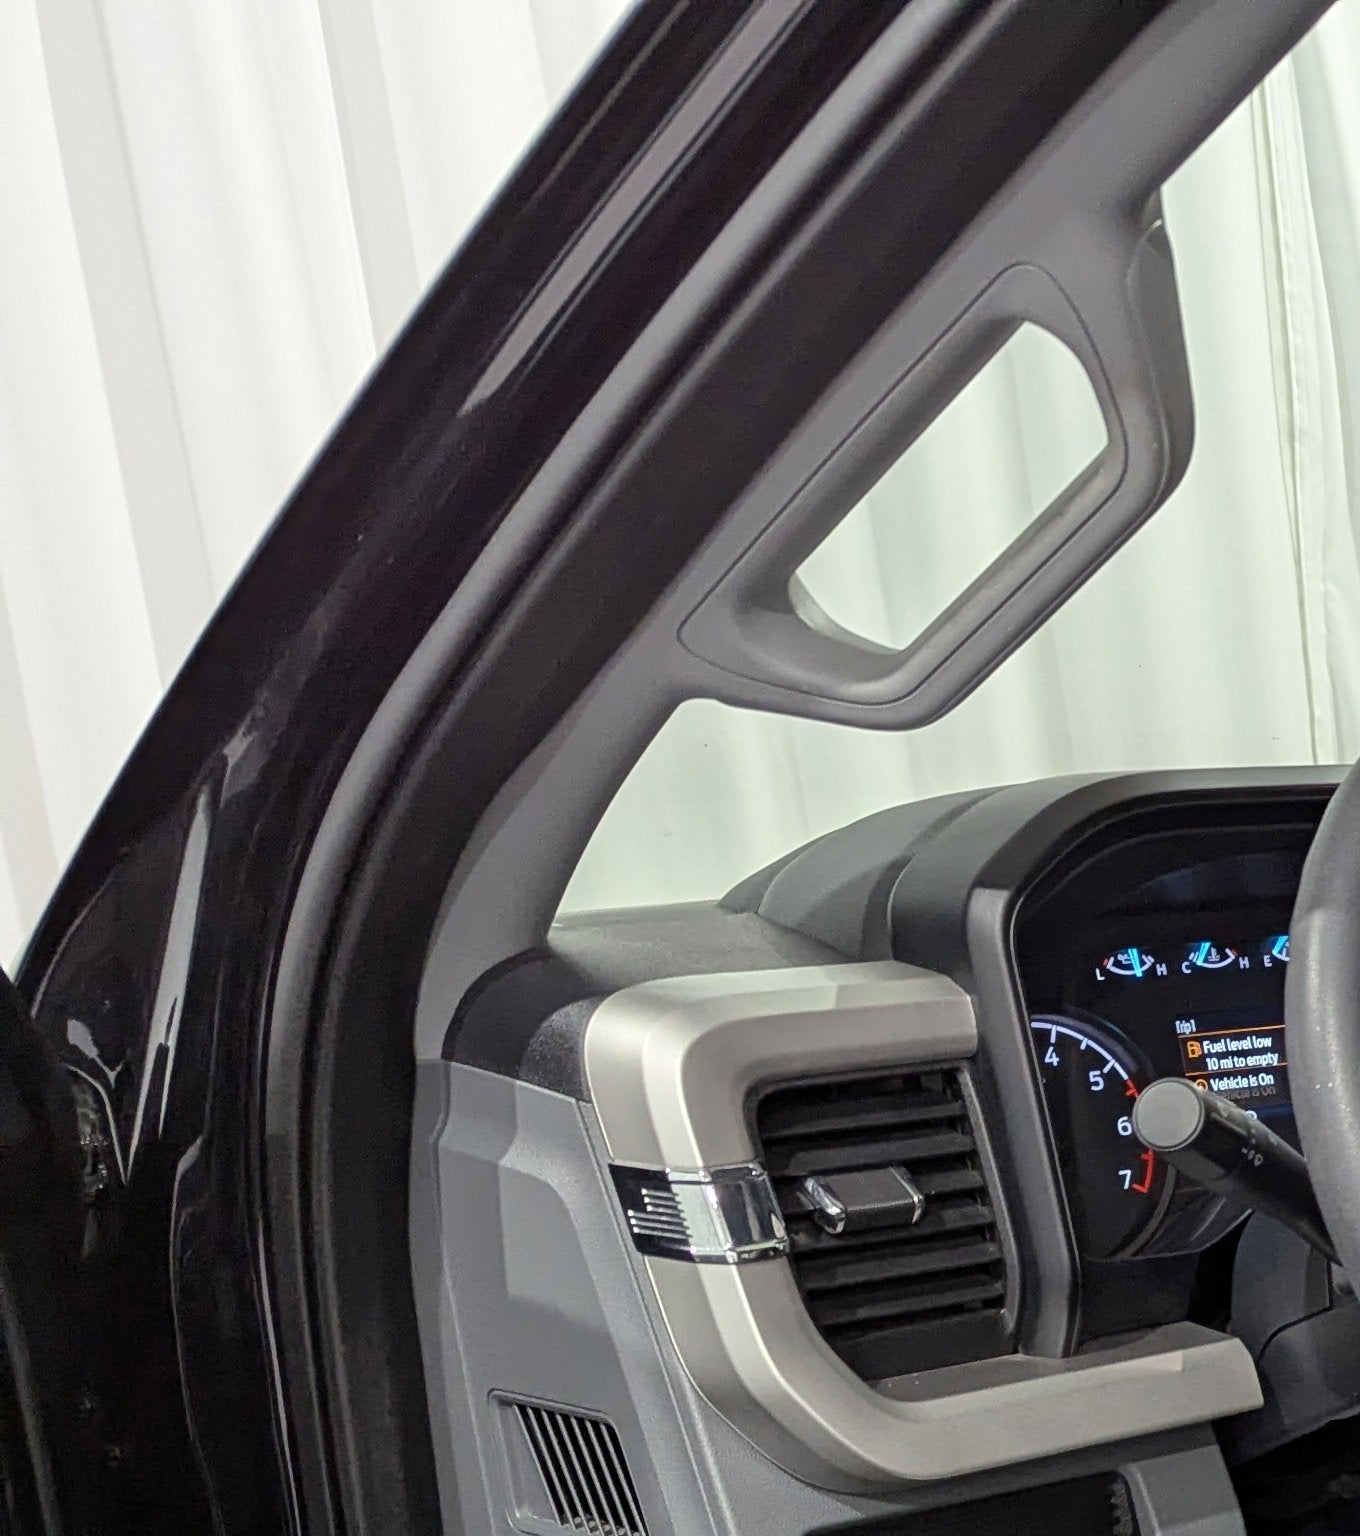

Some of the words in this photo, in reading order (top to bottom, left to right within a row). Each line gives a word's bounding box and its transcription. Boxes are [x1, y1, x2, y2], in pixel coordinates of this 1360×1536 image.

[1155, 963, 1168, 977] H
[1181, 961, 1192, 974] C
[1239, 956, 1250, 969] H
[1263, 954, 1273, 968] E
[1095, 967, 1106, 981] L
[1202, 1038, 1226, 1055] Fuel
[1227, 1036, 1252, 1051] level
[1252, 1035, 1272, 1048] low
[1044, 1046, 1060, 1067] 4
[1205, 1057, 1219, 1071] 10
[1220, 1056, 1234, 1069] mi
[1233, 1056, 1246, 1068] to
[1246, 1052, 1279, 1068] empty
[1088, 1069, 1105, 1091] 5
[1209, 1075, 1248, 1092] Vehicle
[1248, 1074, 1258, 1087] is
[1258, 1072, 1275, 1087] On
[1117, 1116, 1132, 1136] 6
[1118, 1169, 1132, 1190] 7
